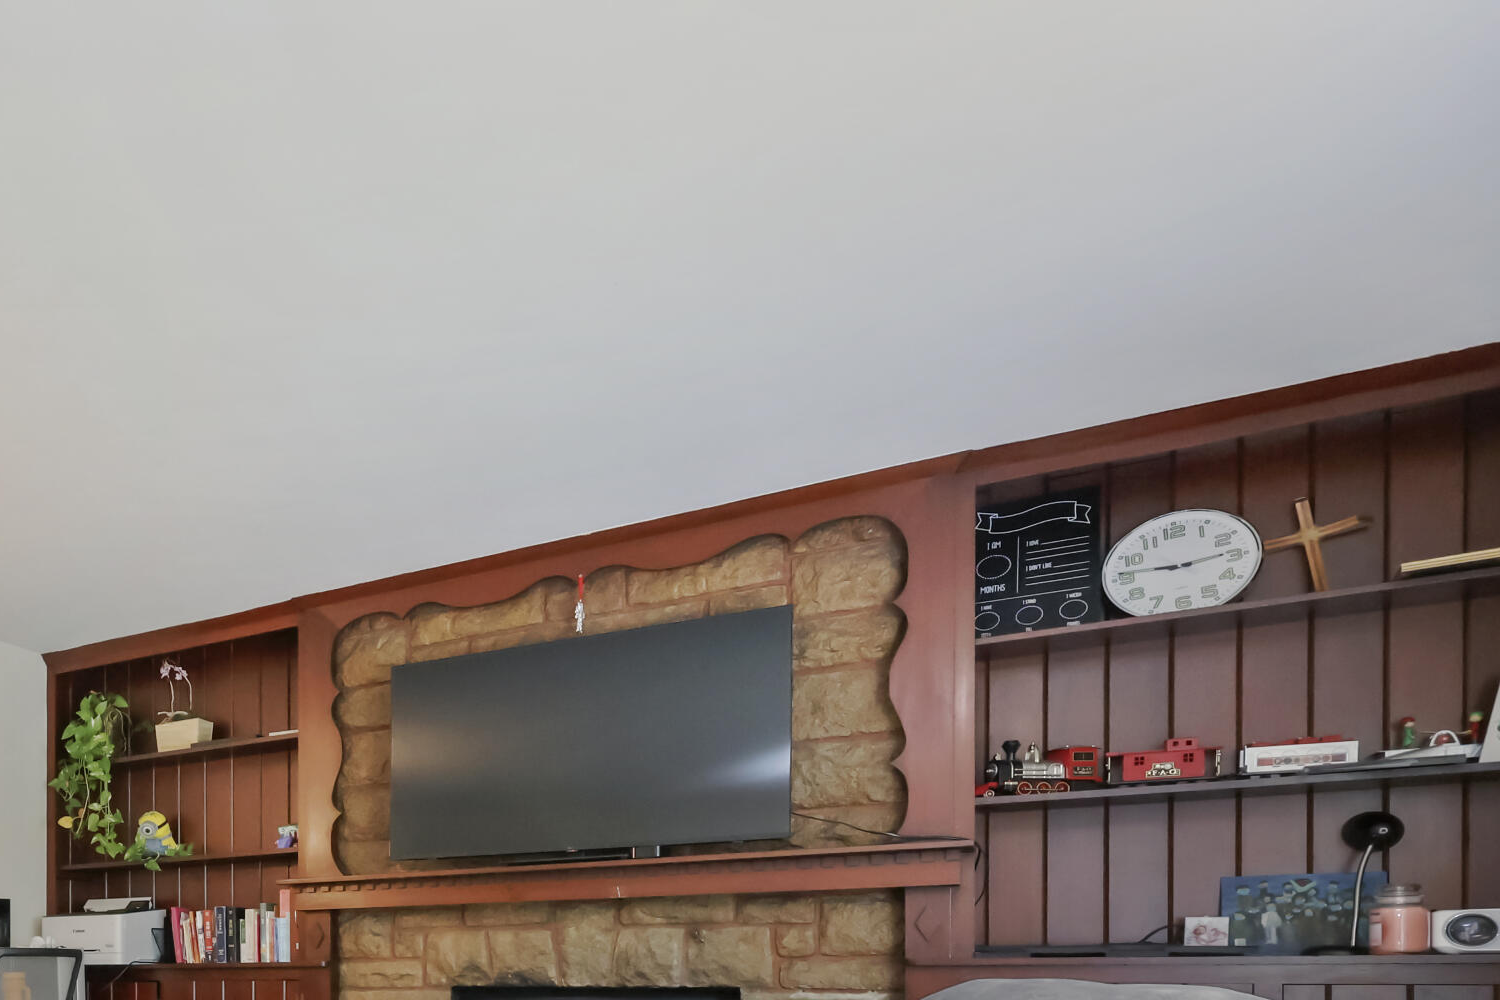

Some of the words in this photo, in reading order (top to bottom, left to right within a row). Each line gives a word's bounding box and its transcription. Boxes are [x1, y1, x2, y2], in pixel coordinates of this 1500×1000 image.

[1163, 525, 1186, 540] 12
[1199, 525, 1205, 538] 1
[991, 541, 1001, 549] AM
[1143, 536, 1159, 550] 11
[1214, 532, 1232, 548] 2
[1124, 553, 1144, 567] 10
[1225, 548, 1243, 562] 3
[1118, 571, 1135, 585] 9
[1219, 567, 1236, 580] 4
[980, 584, 1006, 594] MONTHS
[1128, 587, 1146, 600] 8
[1201, 584, 1219, 599] 5
[1149, 595, 1164, 609] 7
[1174, 596, 1192, 609] 6
